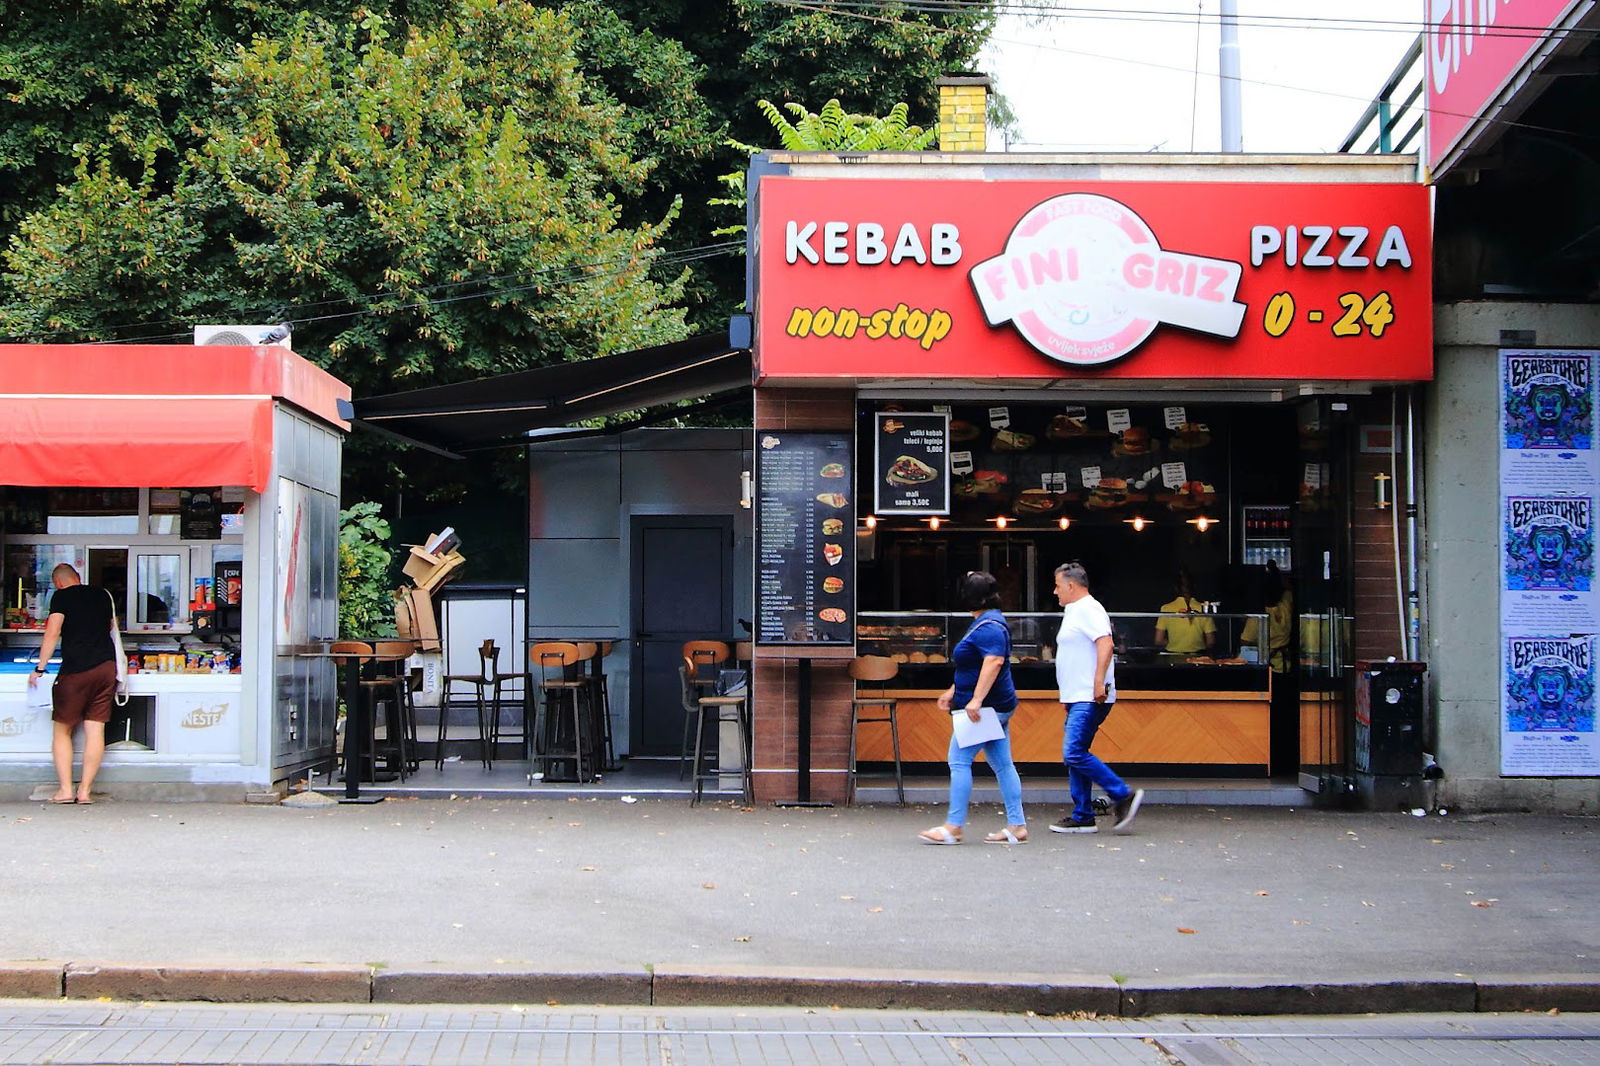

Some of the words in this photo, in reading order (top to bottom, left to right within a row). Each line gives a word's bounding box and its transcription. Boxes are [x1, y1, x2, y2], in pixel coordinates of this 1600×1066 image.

[785, 219, 963, 266] KEBAB
[1250, 224, 1412, 269] PIZZA
[983, 247, 1080, 301] FINI
[1122, 252, 1229, 303] GRIZ
[785, 302, 953, 351] non-stop
[1263, 290, 1296, 337] 0
[1330, 290, 1395, 337] 24
[1511, 359, 1587, 388] BEARSTONE
[1512, 500, 1587, 530] BEARSTONE
[1513, 641, 1589, 670] BEARSTONE
